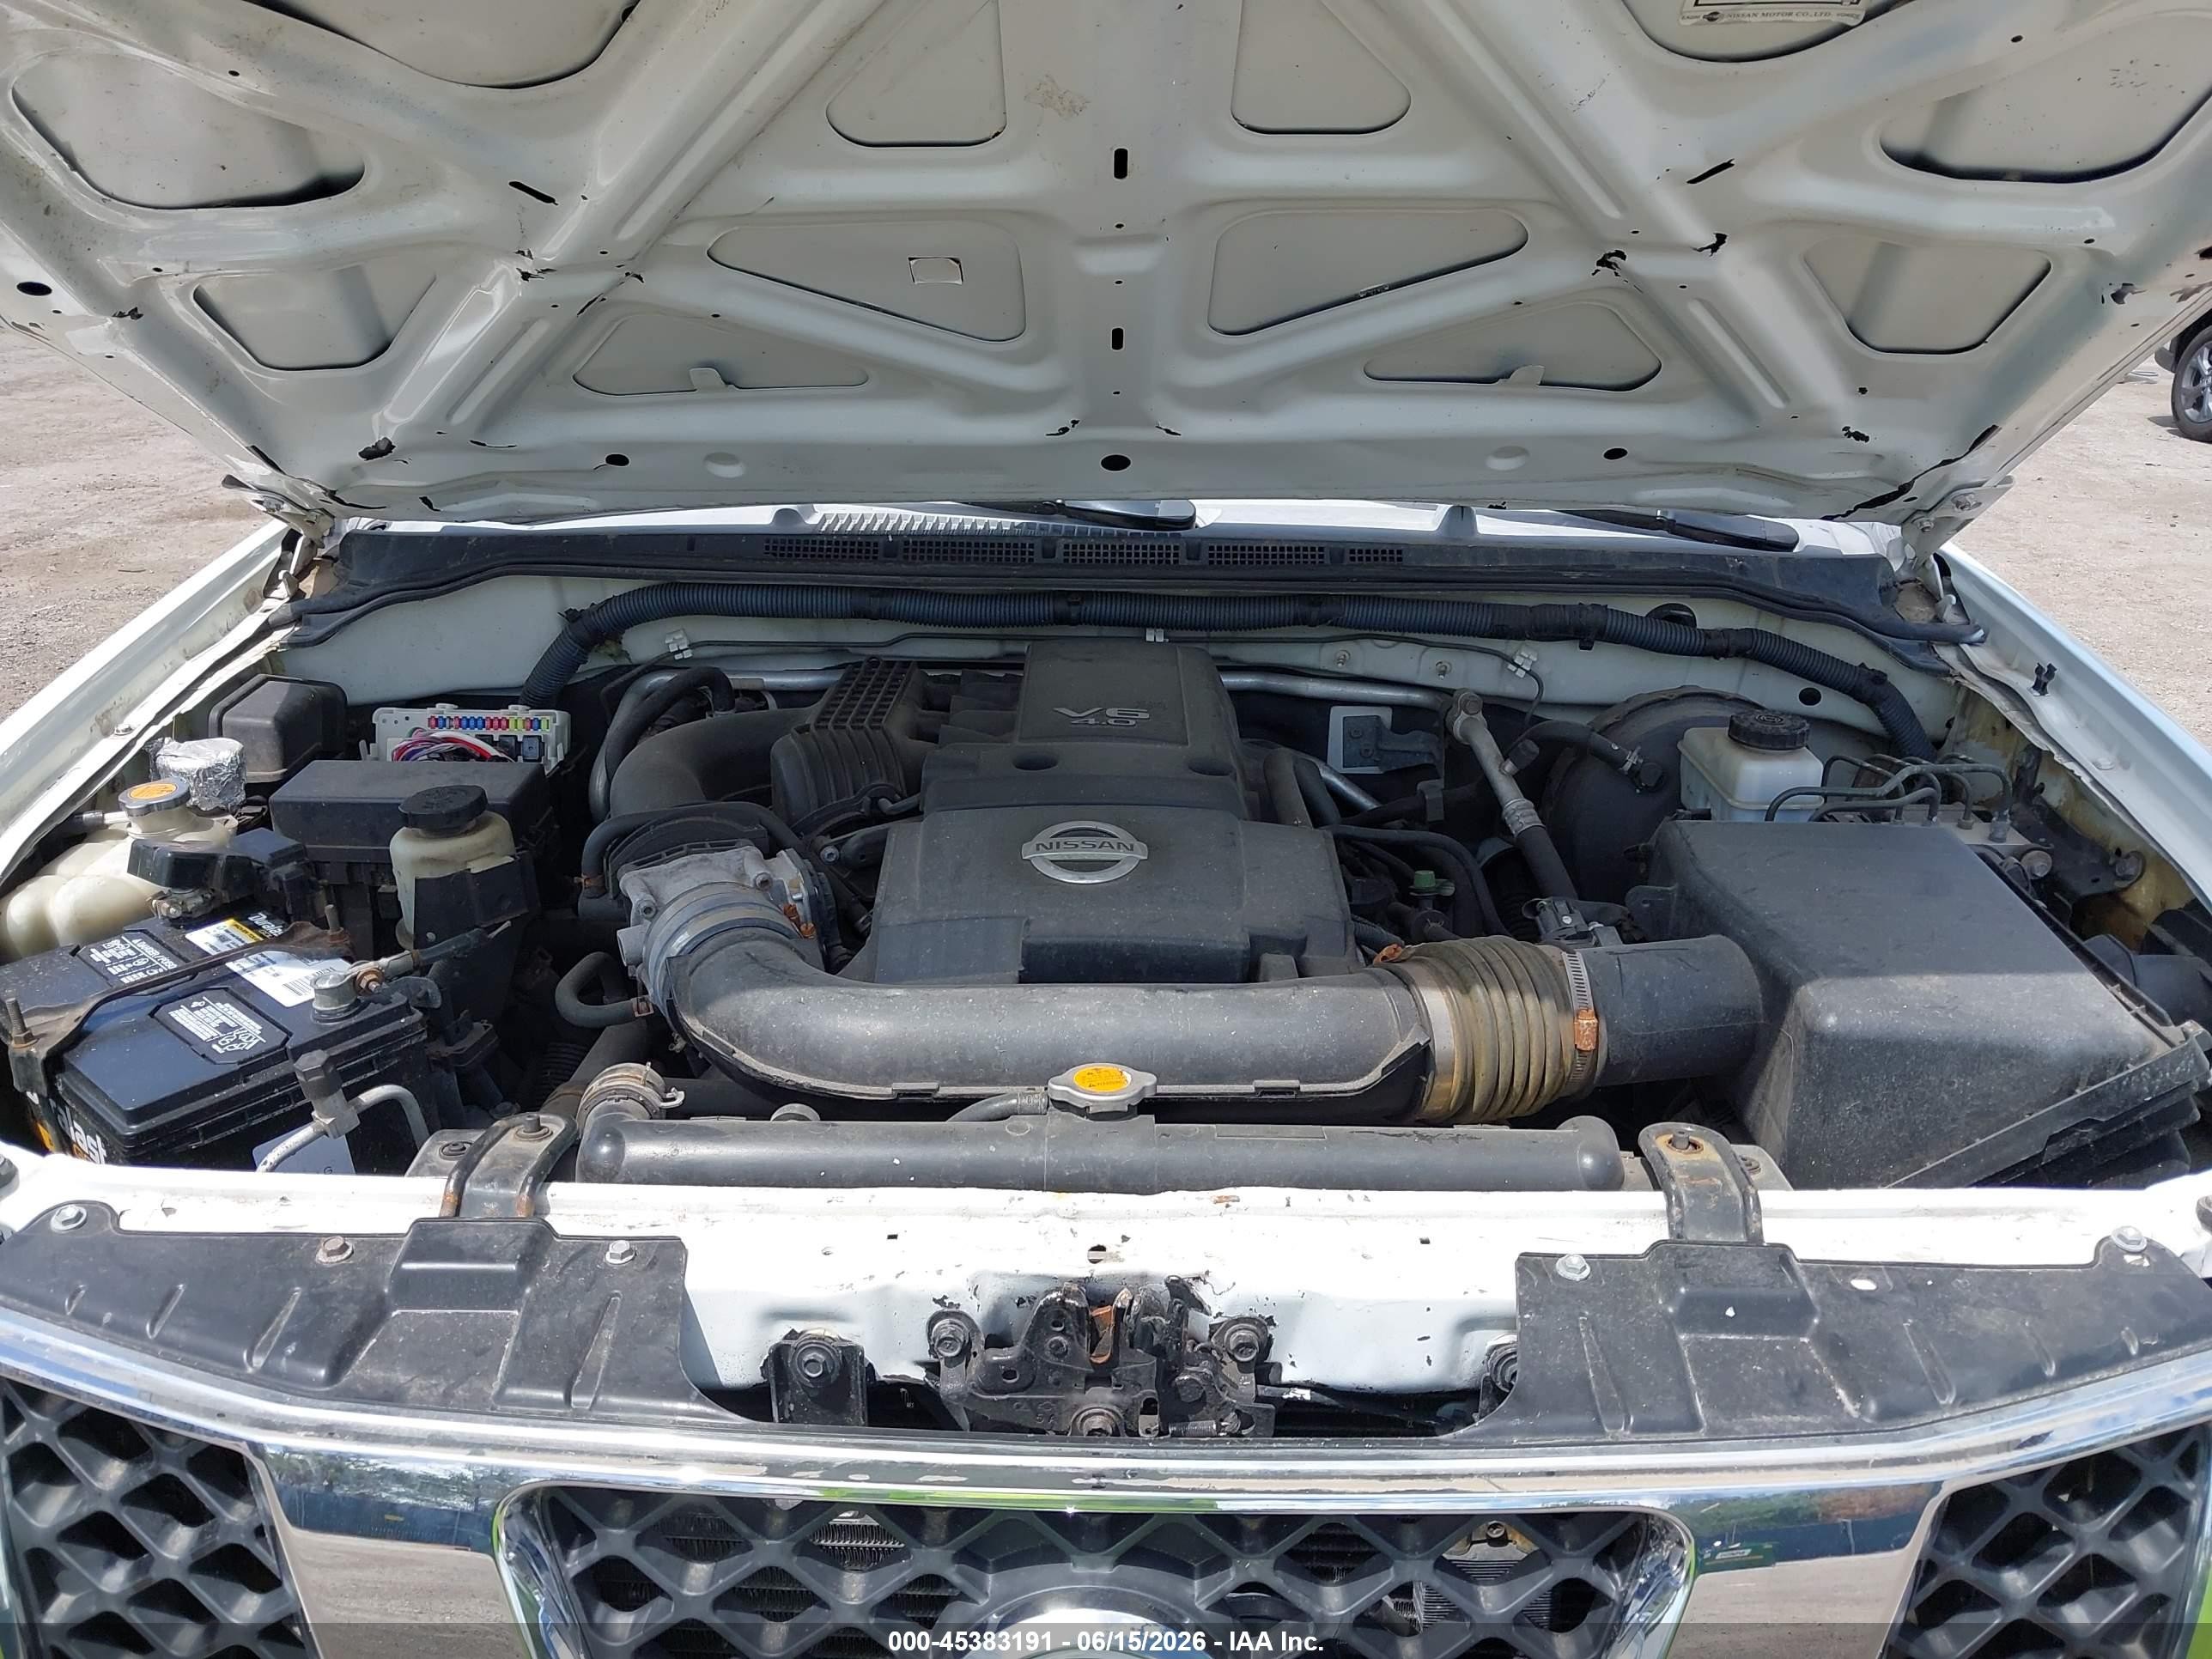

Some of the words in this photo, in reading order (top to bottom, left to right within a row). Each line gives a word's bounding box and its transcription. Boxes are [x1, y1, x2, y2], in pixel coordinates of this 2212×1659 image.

[1053, 707, 1151, 720] V6
[1071, 718, 1137, 726] 4.0
[1035, 839, 1135, 853] NISSAN
